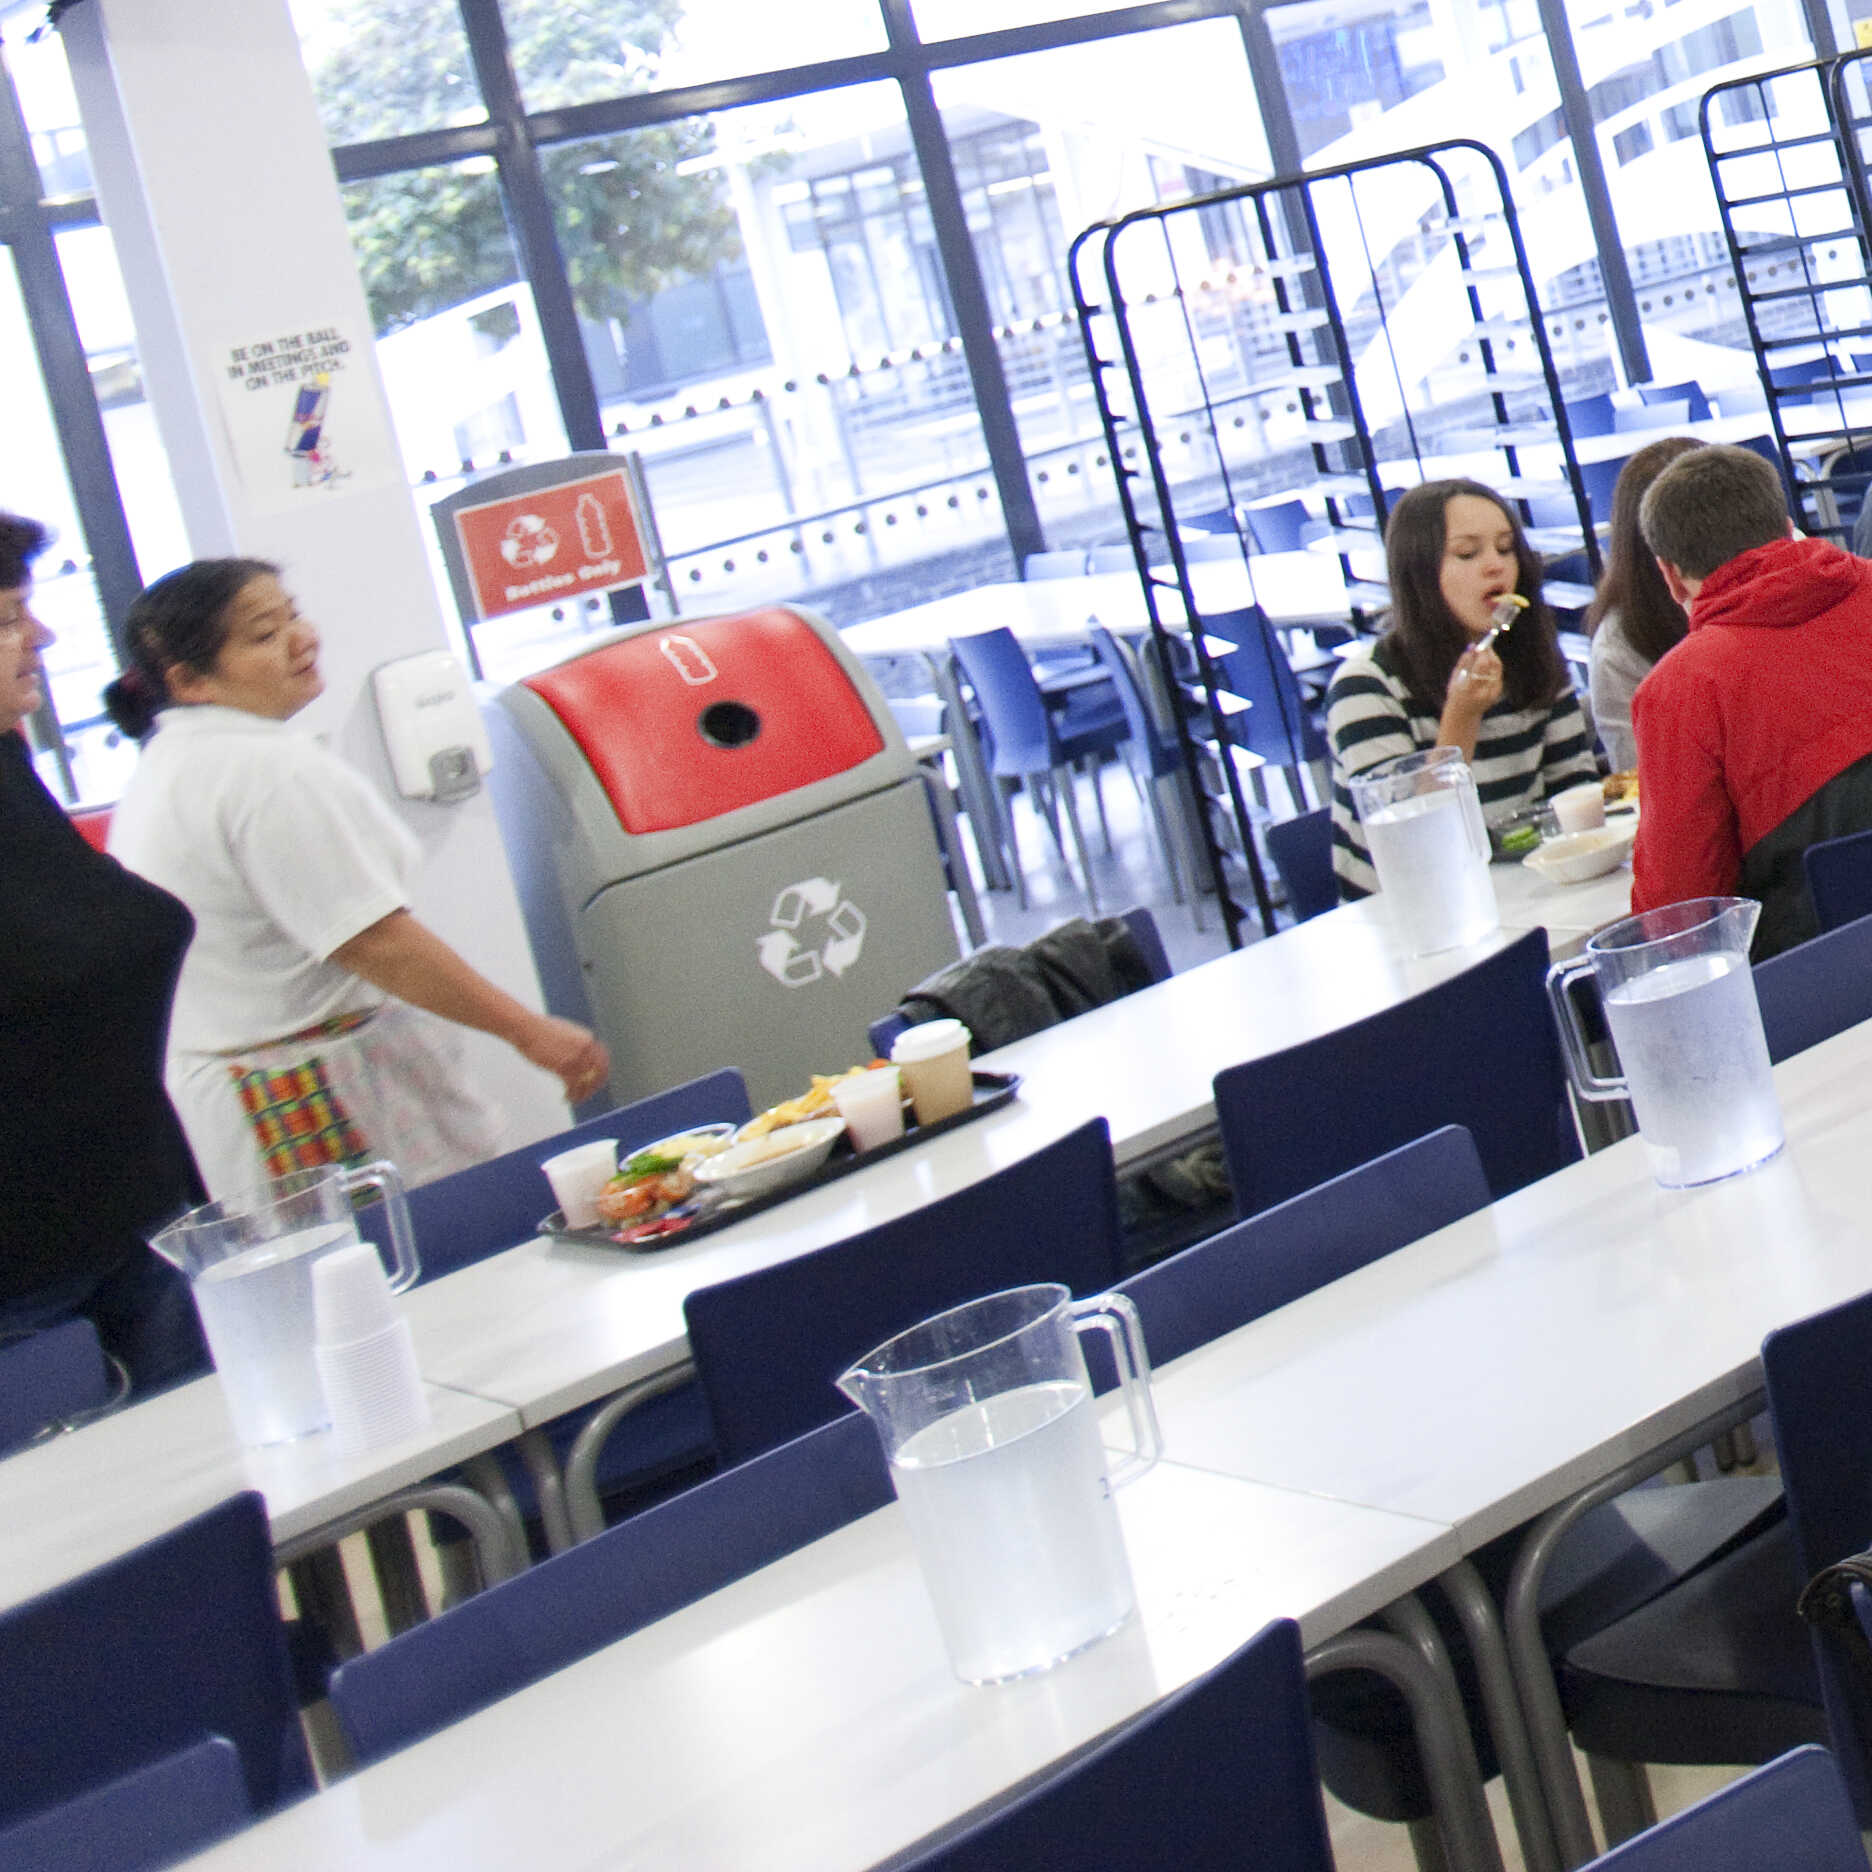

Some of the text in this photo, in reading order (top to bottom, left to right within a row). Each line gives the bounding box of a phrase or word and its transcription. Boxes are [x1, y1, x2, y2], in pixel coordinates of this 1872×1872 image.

[228, 340, 350, 379] IN MEETINGS AND
[251, 342, 273, 357] ON
[277, 335, 302, 351] THE
[306, 328, 339, 345] BALL
[246, 377, 268, 391] ON
[271, 368, 297, 384] THE
[504, 559, 621, 602] Bottles Only
